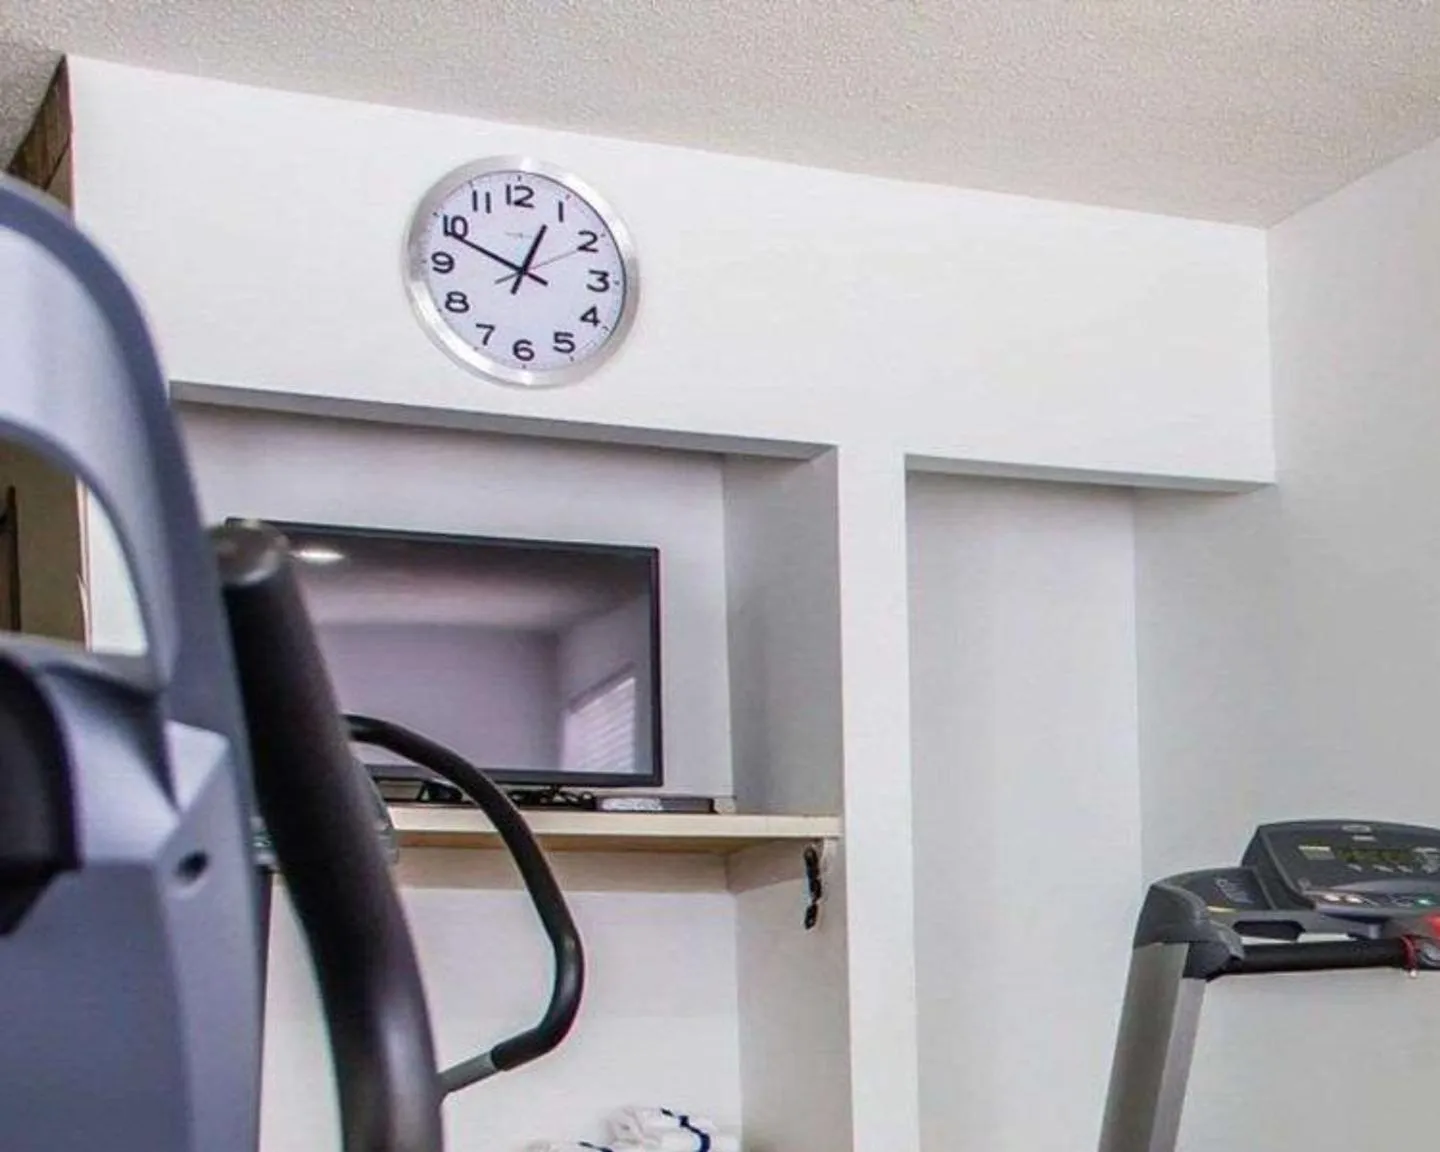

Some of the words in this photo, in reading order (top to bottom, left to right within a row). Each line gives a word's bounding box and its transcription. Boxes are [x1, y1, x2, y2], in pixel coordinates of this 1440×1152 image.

[472, 190, 491, 214] 11
[506, 183, 535, 209] 12
[557, 201, 564, 222] 1
[442, 214, 469, 239] 10
[577, 230, 599, 253] 2
[431, 251, 455, 274] 9
[586, 269, 610, 293] 3
[445, 291, 470, 313] 8
[580, 306, 600, 327] 4
[476, 323, 495, 346] 7
[553, 332, 576, 354] 5
[512, 339, 535, 362] 6
